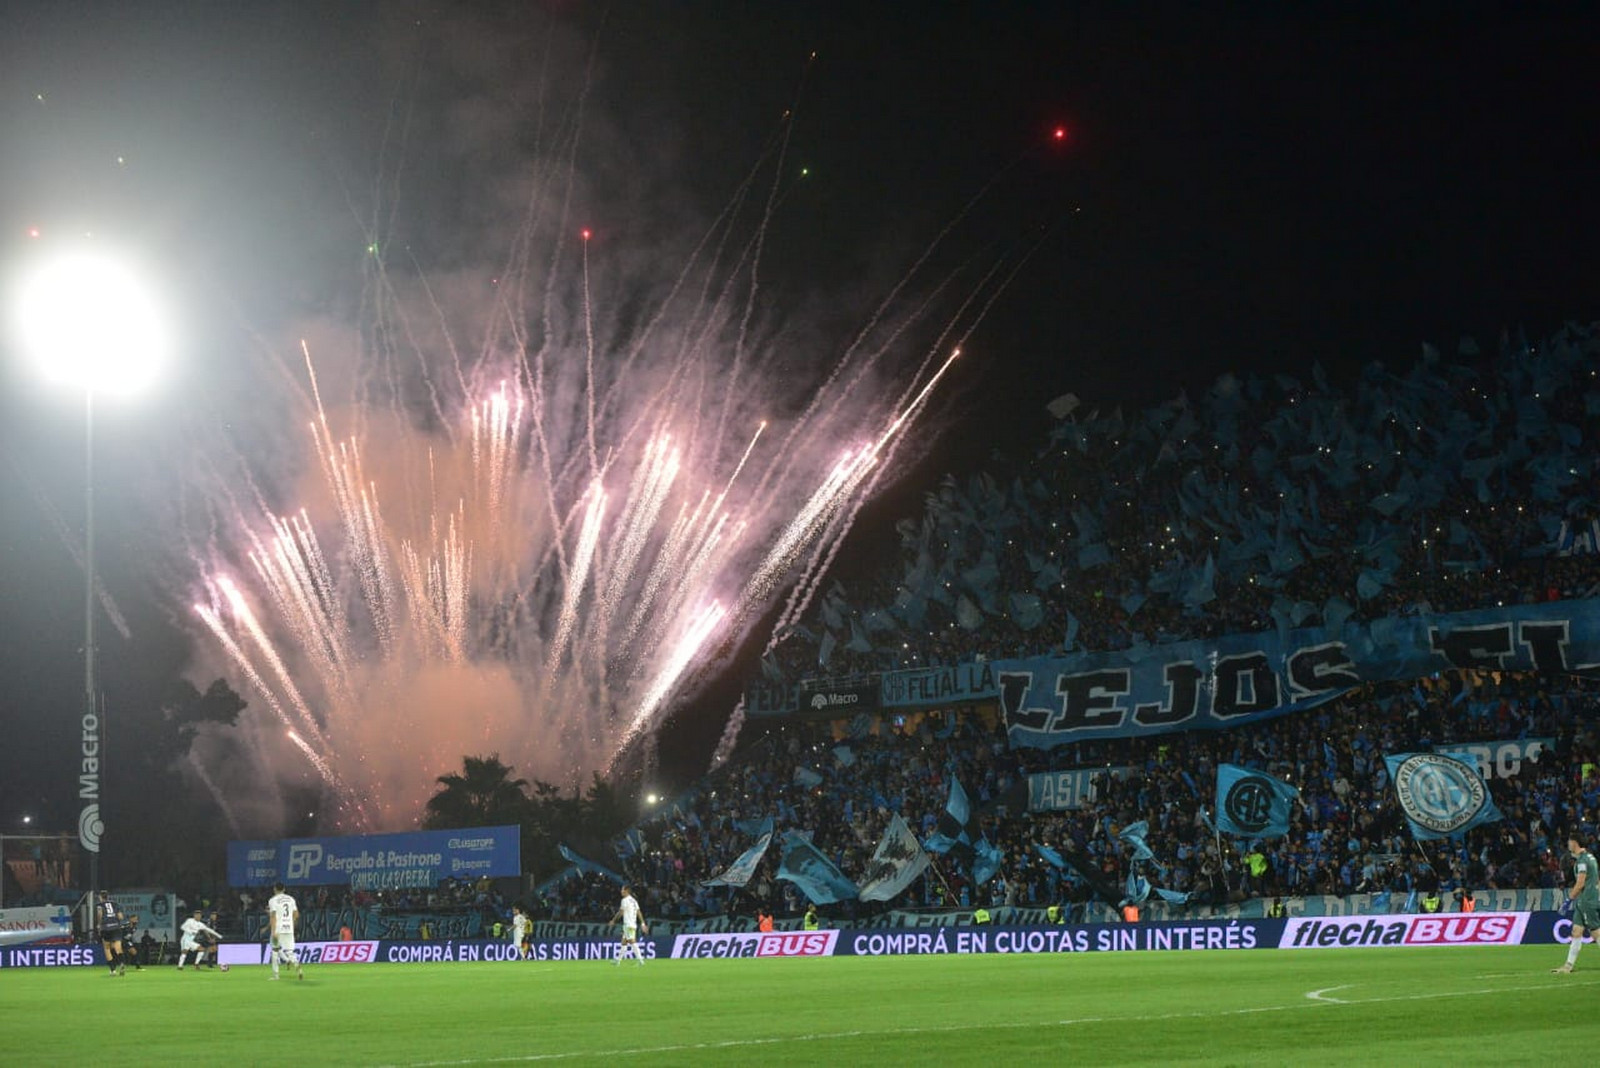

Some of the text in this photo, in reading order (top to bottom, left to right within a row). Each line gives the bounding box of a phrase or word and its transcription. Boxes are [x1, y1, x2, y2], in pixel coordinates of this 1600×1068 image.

[908, 667, 964, 700] FILIAL
[970, 665, 995, 692] LA
[998, 640, 1361, 735] LEJOS
[828, 693, 858, 705] Macro
[79, 713, 99, 799] Macro
[287, 844, 323, 879] BP
[326, 850, 374, 873] Bergallo
[376, 851, 385, 867] &
[387, 850, 442, 867] Pastrone
[105, 902, 114, 914] 9
[282, 903, 290, 918] 3
[853, 920, 1257, 955] COMPRÁ EN CUOTAS SIN INTERÉS
[10, 944, 94, 967] INTERÉS
[388, 940, 453, 963] COMPRÁ
[458, 945, 479, 962] EN
[484, 943, 548, 962] CUOAS
[552, 943, 579, 961] SIN
